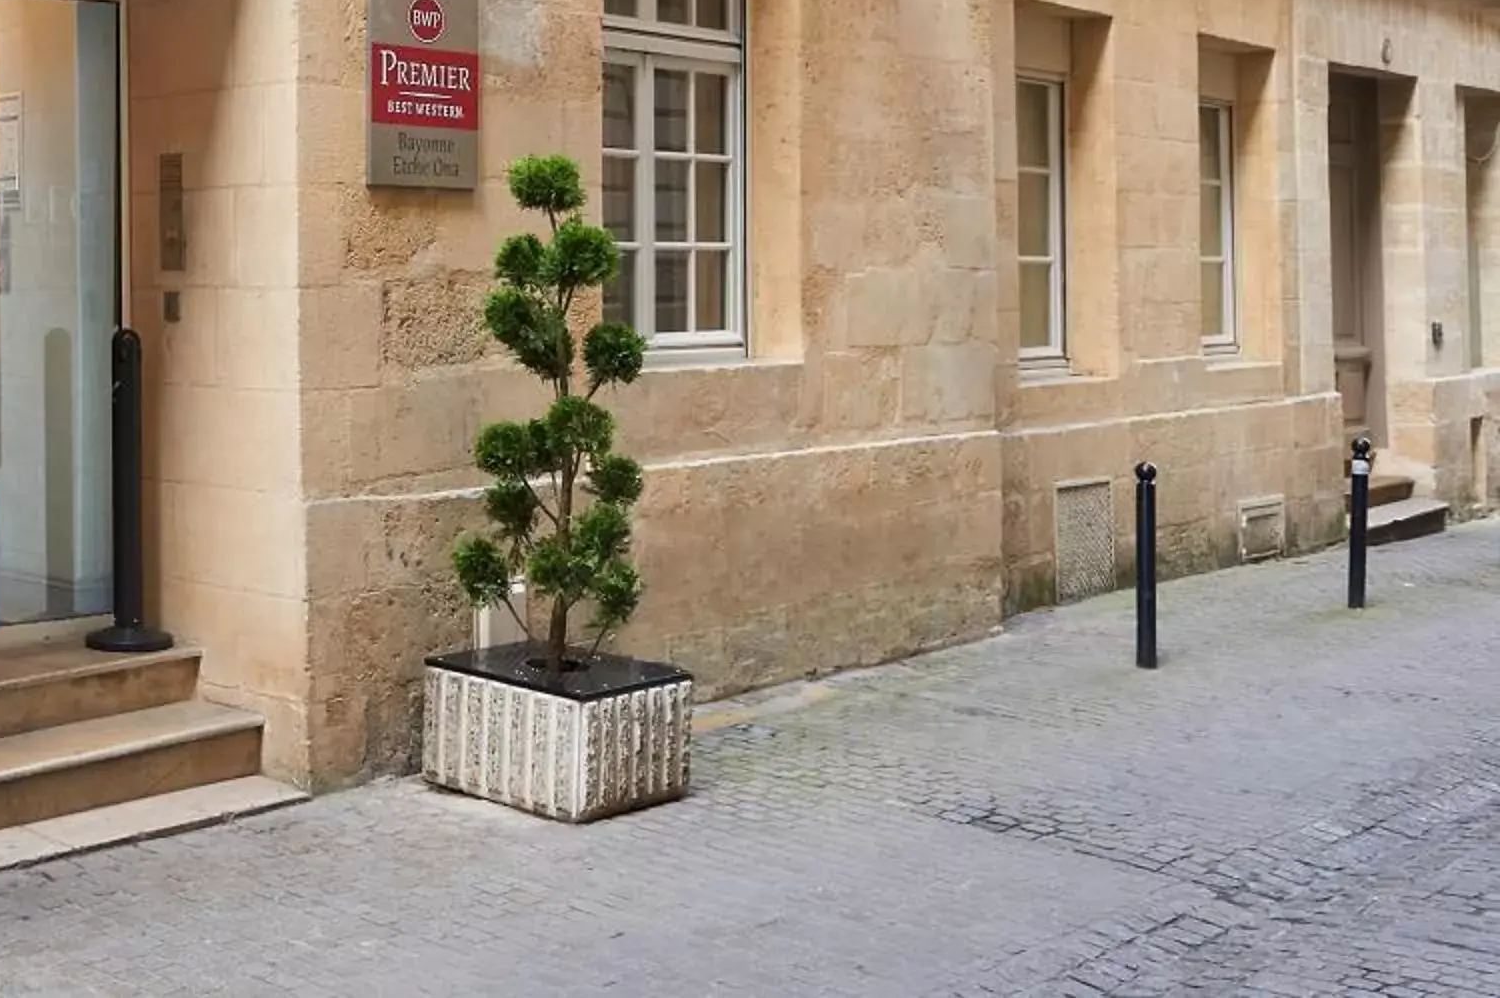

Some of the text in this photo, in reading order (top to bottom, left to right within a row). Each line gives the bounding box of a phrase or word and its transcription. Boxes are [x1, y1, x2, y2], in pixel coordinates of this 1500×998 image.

[413, 8, 442, 29] BWP
[380, 49, 471, 92] PREMIER
[387, 100, 463, 120] BEST WESTERN
[398, 131, 456, 154] Bayonne
